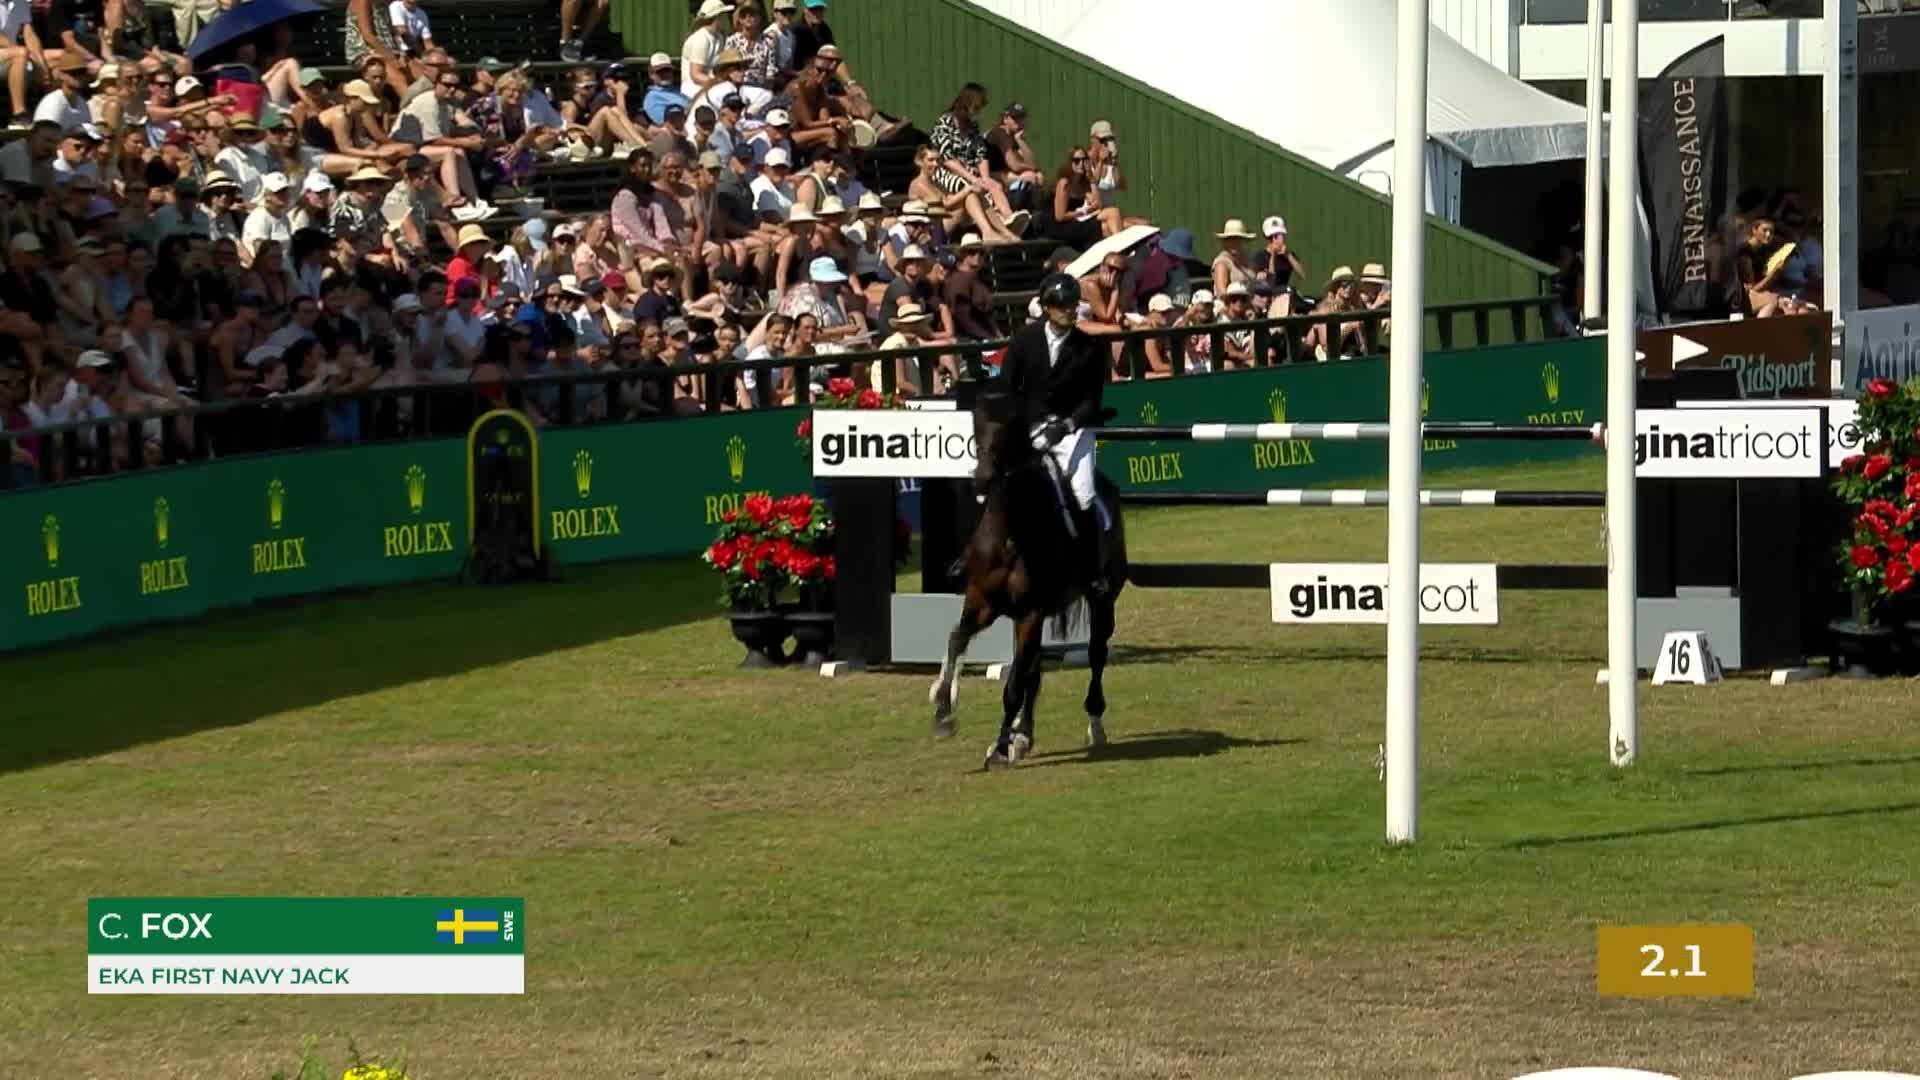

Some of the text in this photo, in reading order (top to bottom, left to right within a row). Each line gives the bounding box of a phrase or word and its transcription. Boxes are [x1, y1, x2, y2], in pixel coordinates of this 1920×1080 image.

[1673, 78, 1706, 282] RENAISSANCE
[1720, 352, 1816, 398] Ridsport
[820, 425, 977, 466] ginatric
[1254, 439, 1315, 470] ROLEX
[1128, 452, 1183, 484] ROLEX
[384, 521, 453, 557] ROLEX
[552, 505, 620, 539] ROLEX
[253, 537, 305, 574] ROLEX
[140, 556, 189, 595] ROLEX
[26, 576, 81, 616] ROLEX
[1289, 575, 1480, 618] ginacot
[1668, 639, 1691, 676] 16
